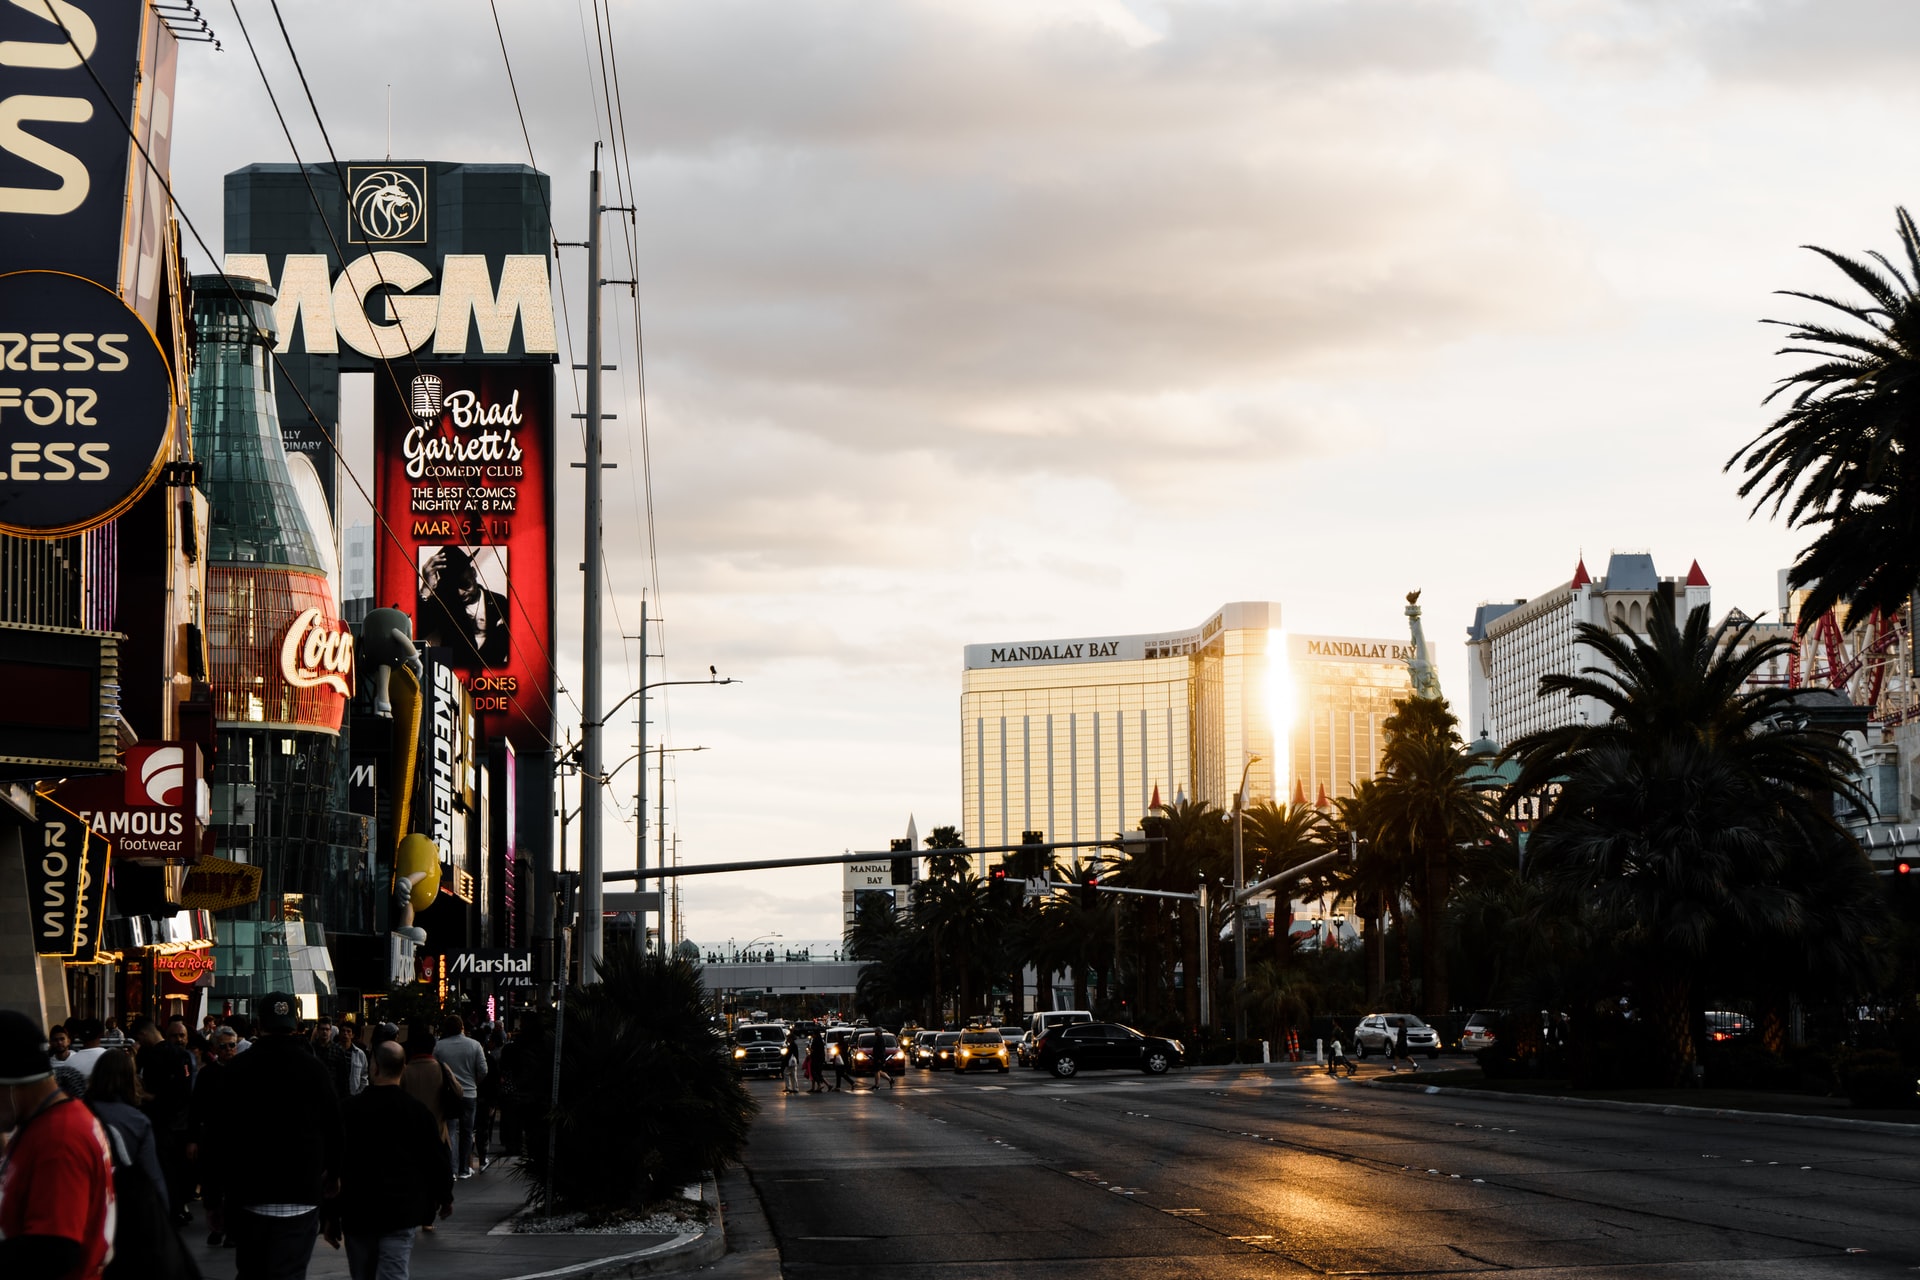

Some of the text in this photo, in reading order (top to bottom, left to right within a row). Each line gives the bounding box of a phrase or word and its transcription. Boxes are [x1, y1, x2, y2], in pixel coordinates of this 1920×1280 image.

[223, 250, 558, 360] MGM
[0, 387, 98, 426] FOR
[443, 389, 523, 428] Brad
[403, 426, 523, 478] Garrett's
[425, 465, 523, 477] COMEDY CLUB
[412, 487, 516, 498] THE BEST COMICS
[412, 499, 516, 511] NIGHTLY AT 8 P.M.
[413, 520, 455, 535] MAR.
[462, 520, 471, 535] 5
[493, 520, 510, 535] 11
[280, 607, 354, 700] Coca
[990, 641, 1120, 663] MANDALAY BAY
[1307, 640, 1418, 660] MANDALAY BAY
[467, 676, 517, 692] JONES
[473, 696, 508, 710] DDIE
[433, 661, 453, 867] SKECHERS
[79, 809, 184, 836] FAMOUS
[119, 837, 183, 852] footwear
[41, 821, 69, 938] ROSS
[866, 876, 883, 885] BAY
[158, 956, 214, 971] Hard Rock
